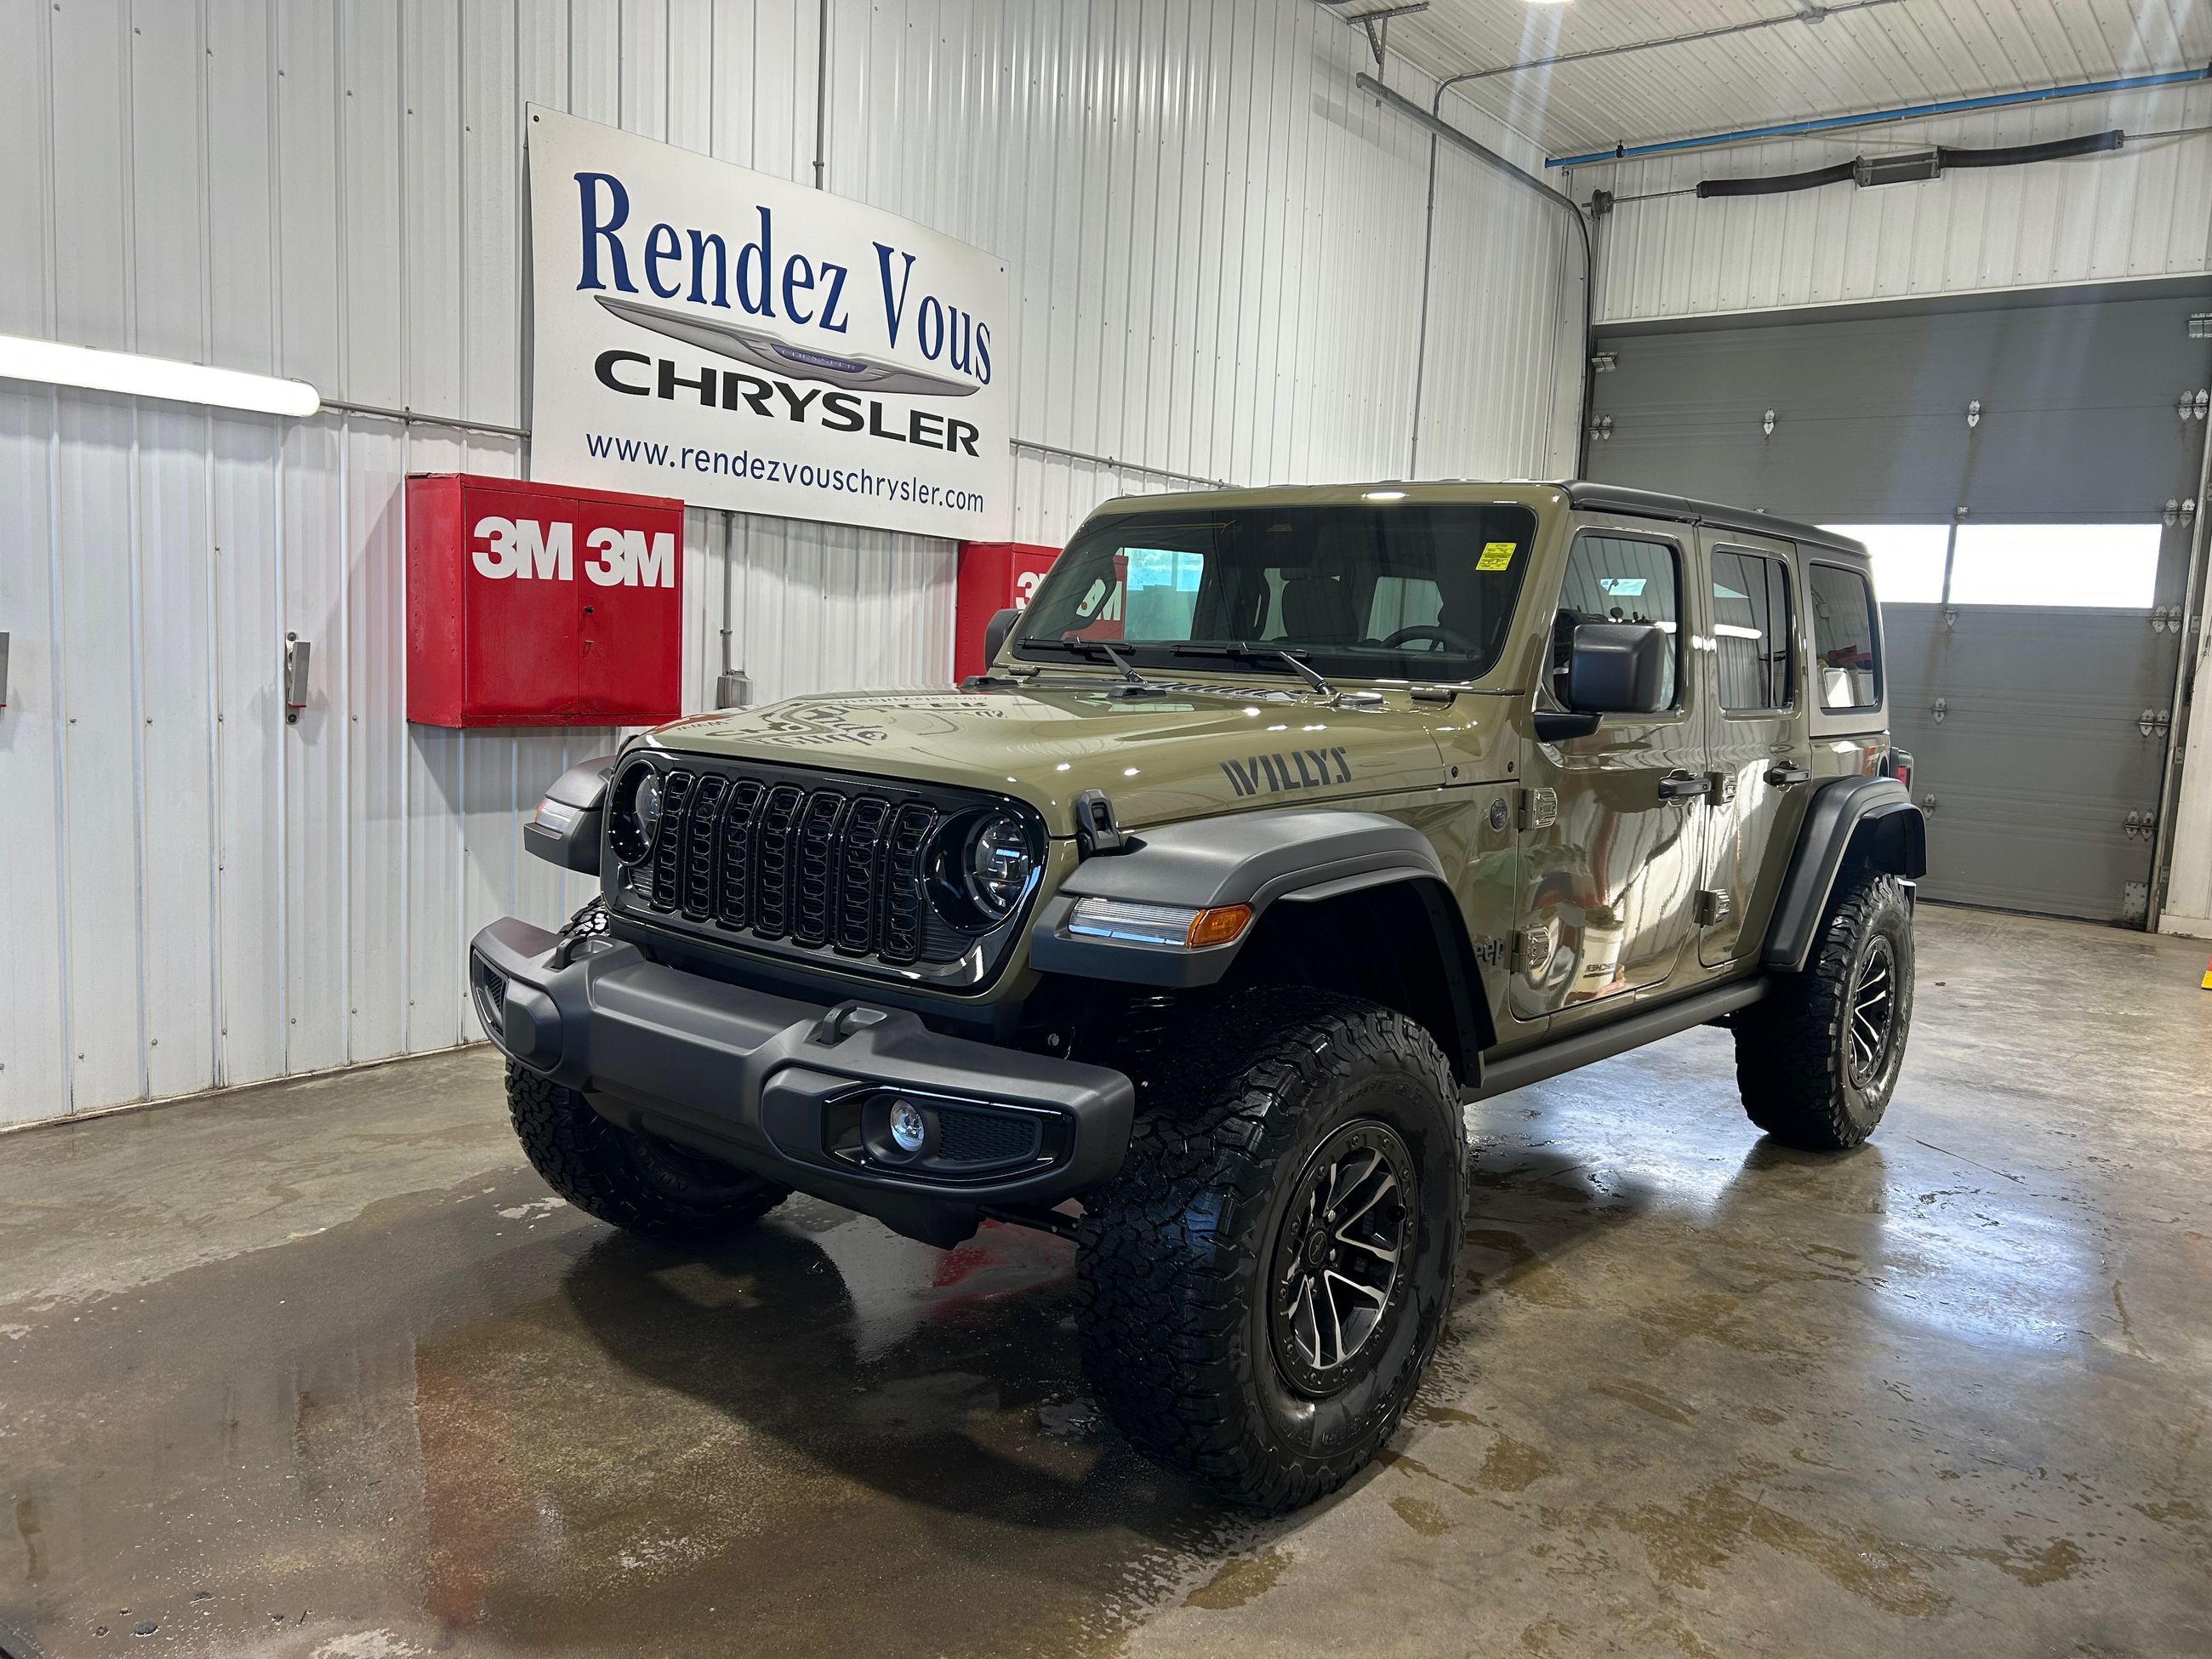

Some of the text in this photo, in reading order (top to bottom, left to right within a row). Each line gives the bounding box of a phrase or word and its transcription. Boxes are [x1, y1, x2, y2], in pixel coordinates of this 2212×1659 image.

[574, 172, 991, 385] Rendez Vous
[594, 350, 980, 458] CHRYSLER
[585, 433, 984, 513] www.rendezvouschrysler.com
[472, 516, 573, 581] 3M
[584, 527, 675, 588] 3M
[1219, 747, 1352, 796] WILLYS
[1474, 938, 1505, 966] eep
